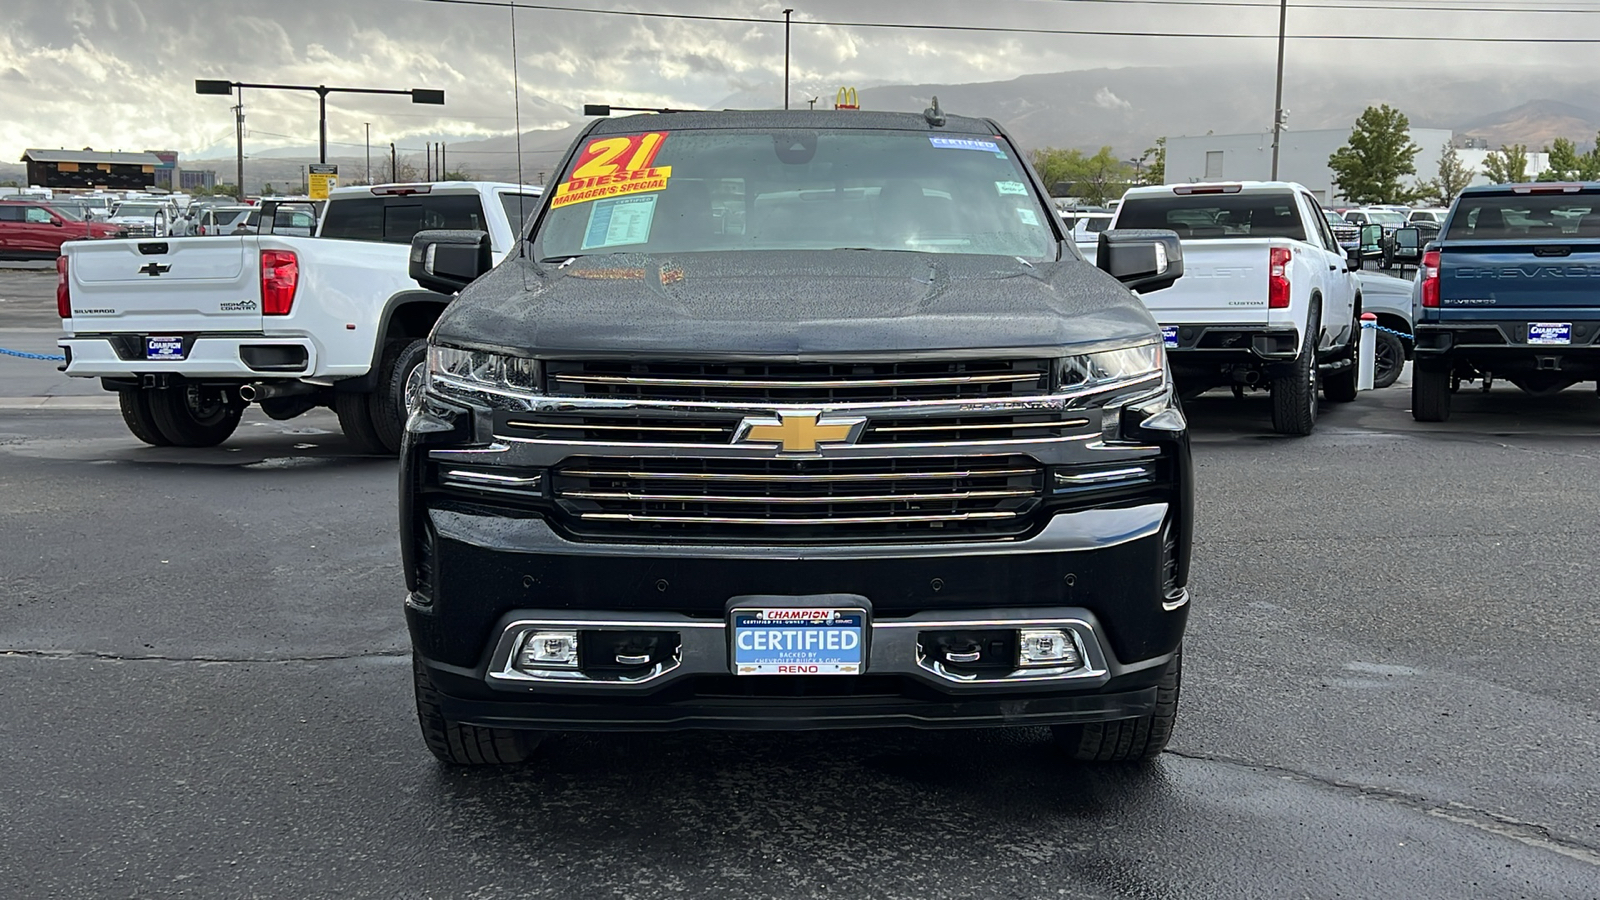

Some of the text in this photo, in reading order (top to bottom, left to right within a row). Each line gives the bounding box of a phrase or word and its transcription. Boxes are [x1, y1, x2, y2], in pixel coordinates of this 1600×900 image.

[933, 138, 994, 149] CERTIFIED
[572, 133, 663, 178] 21
[567, 168, 662, 192] DIESEL
[552, 179, 666, 206] MANAGER'S SPECIAL
[615, 197, 653, 205] CERTIFIED
[1530, 326, 1569, 334] CHAMPION
[149, 341, 181, 349] CHAMPION
[767, 611, 830, 619] CHAMPION
[737, 630, 859, 650] CERTIFIED
[778, 665, 818, 673] RENO
